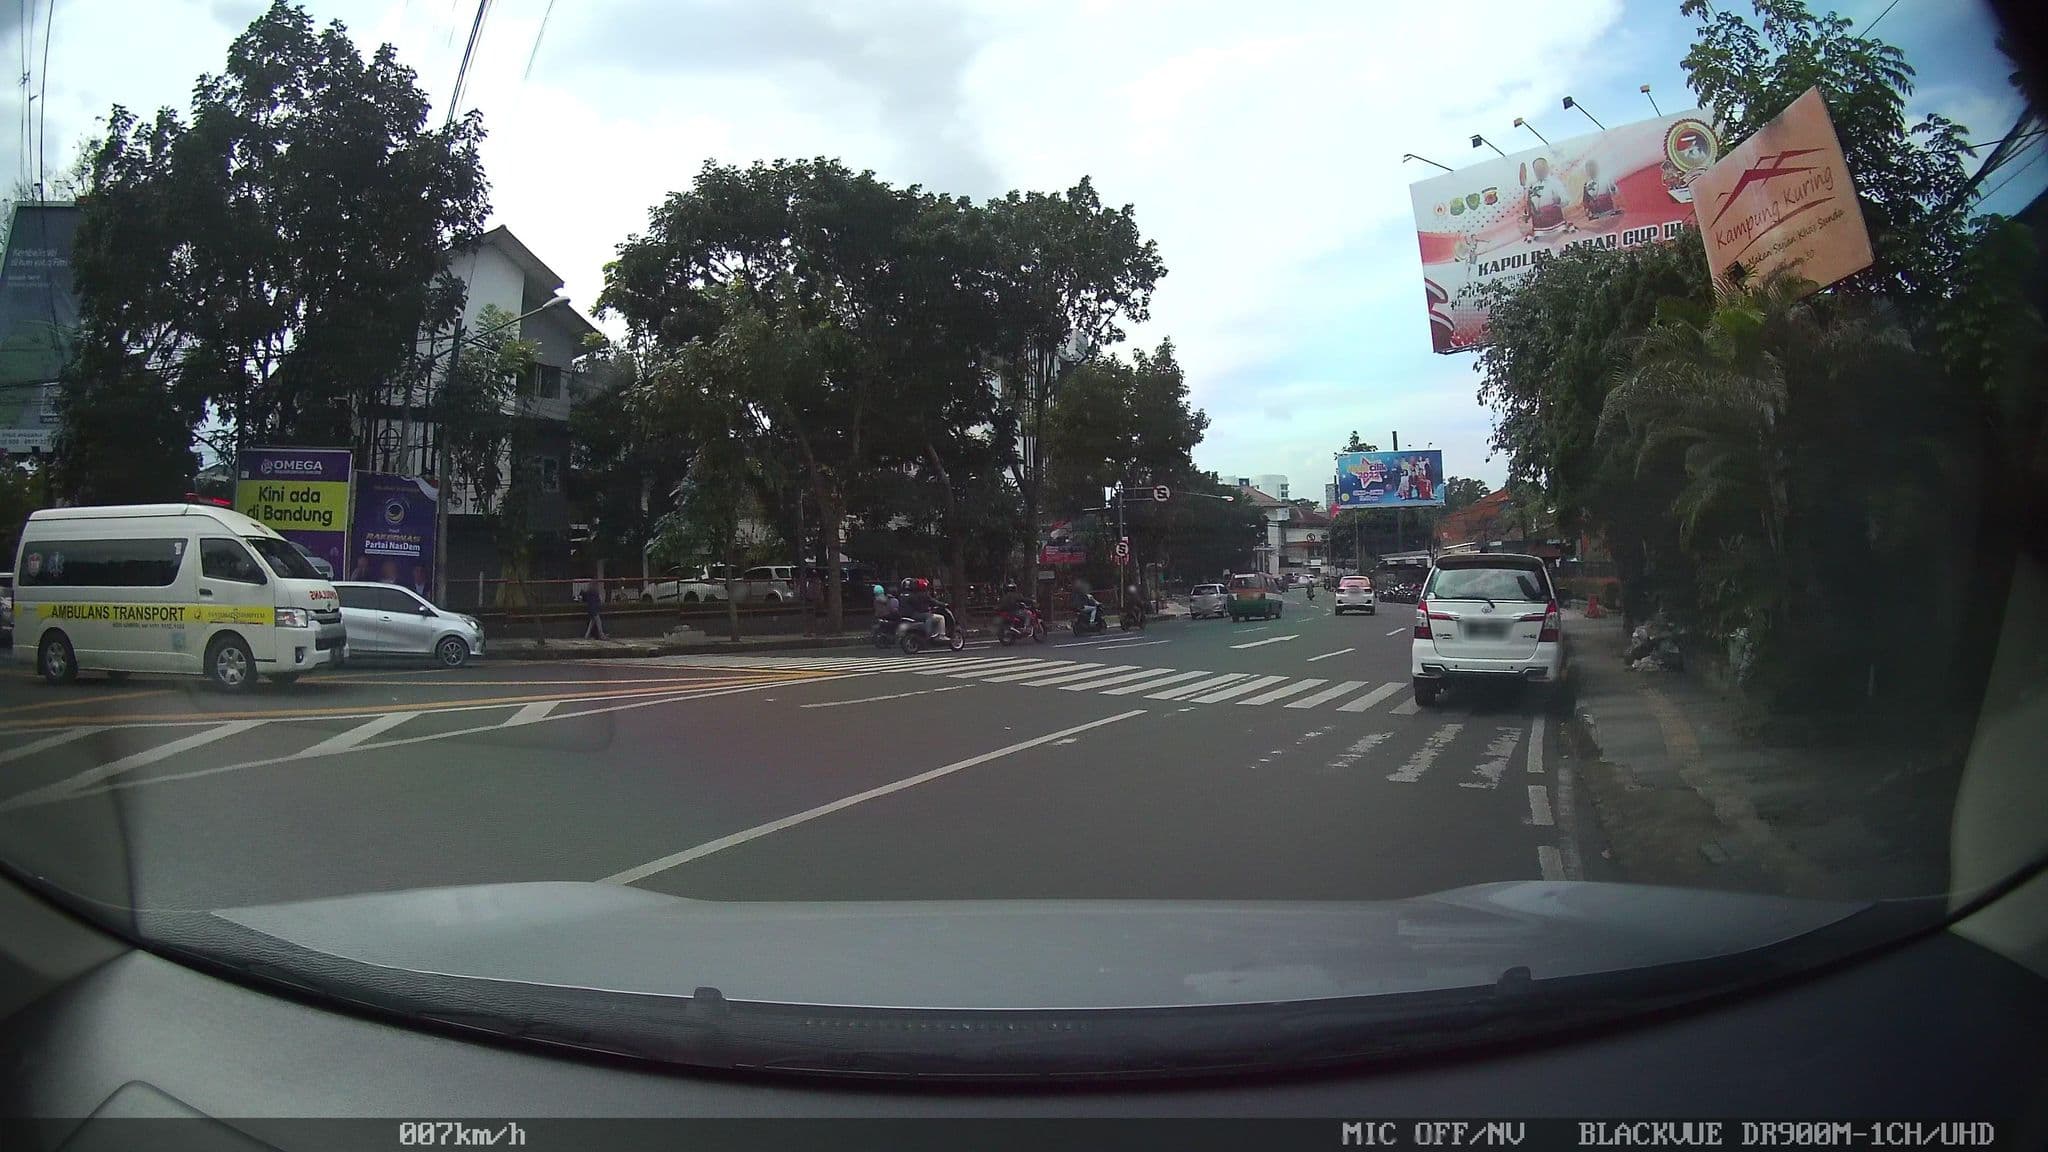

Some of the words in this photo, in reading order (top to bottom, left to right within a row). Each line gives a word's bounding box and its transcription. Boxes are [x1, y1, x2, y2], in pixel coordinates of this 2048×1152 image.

[1715, 200, 1781, 250] Kampung
[1783, 165, 1834, 205] Kuring
[1817, 207, 1845, 231] Sunda
[1622, 225, 1658, 246] CUP
[274, 460, 323, 471] OMEGA
[259, 486, 285, 503] Kini
[289, 487, 321, 503] ada
[247, 504, 259, 520] di
[264, 505, 333, 527] Bandung
[365, 540, 388, 549] Partai
[389, 542, 420, 551] NasDem
[52, 604, 110, 620] AMBULANS
[113, 606, 185, 622] TRANSPORT
